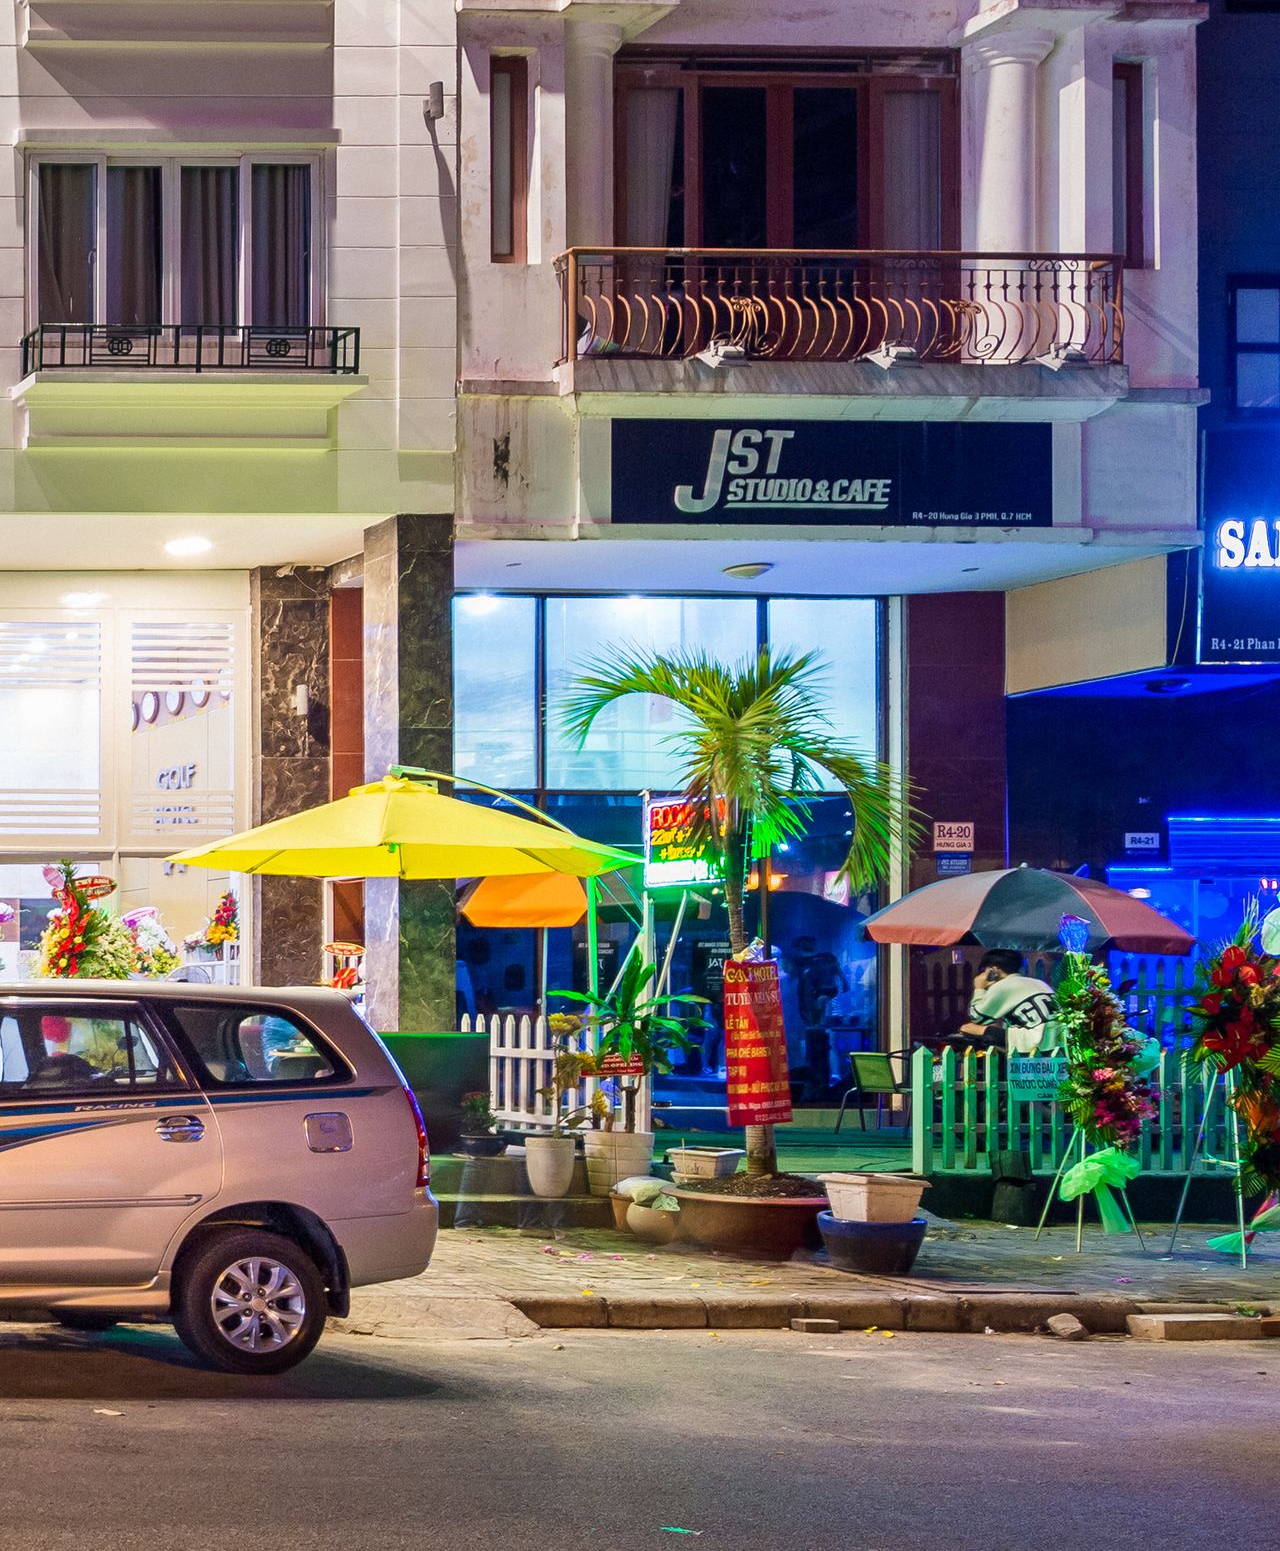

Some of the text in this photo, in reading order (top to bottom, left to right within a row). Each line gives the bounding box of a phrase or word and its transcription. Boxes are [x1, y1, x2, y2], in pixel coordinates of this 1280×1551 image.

[1247, 637, 1276, 651] Phan
[156, 762, 198, 790] GOLF
[936, 825, 971, 839] R4-20
[936, 840, 955, 848] HƯNG
[1130, 836, 1155, 845] R4-21
[74, 1102, 157, 1112] RACING
